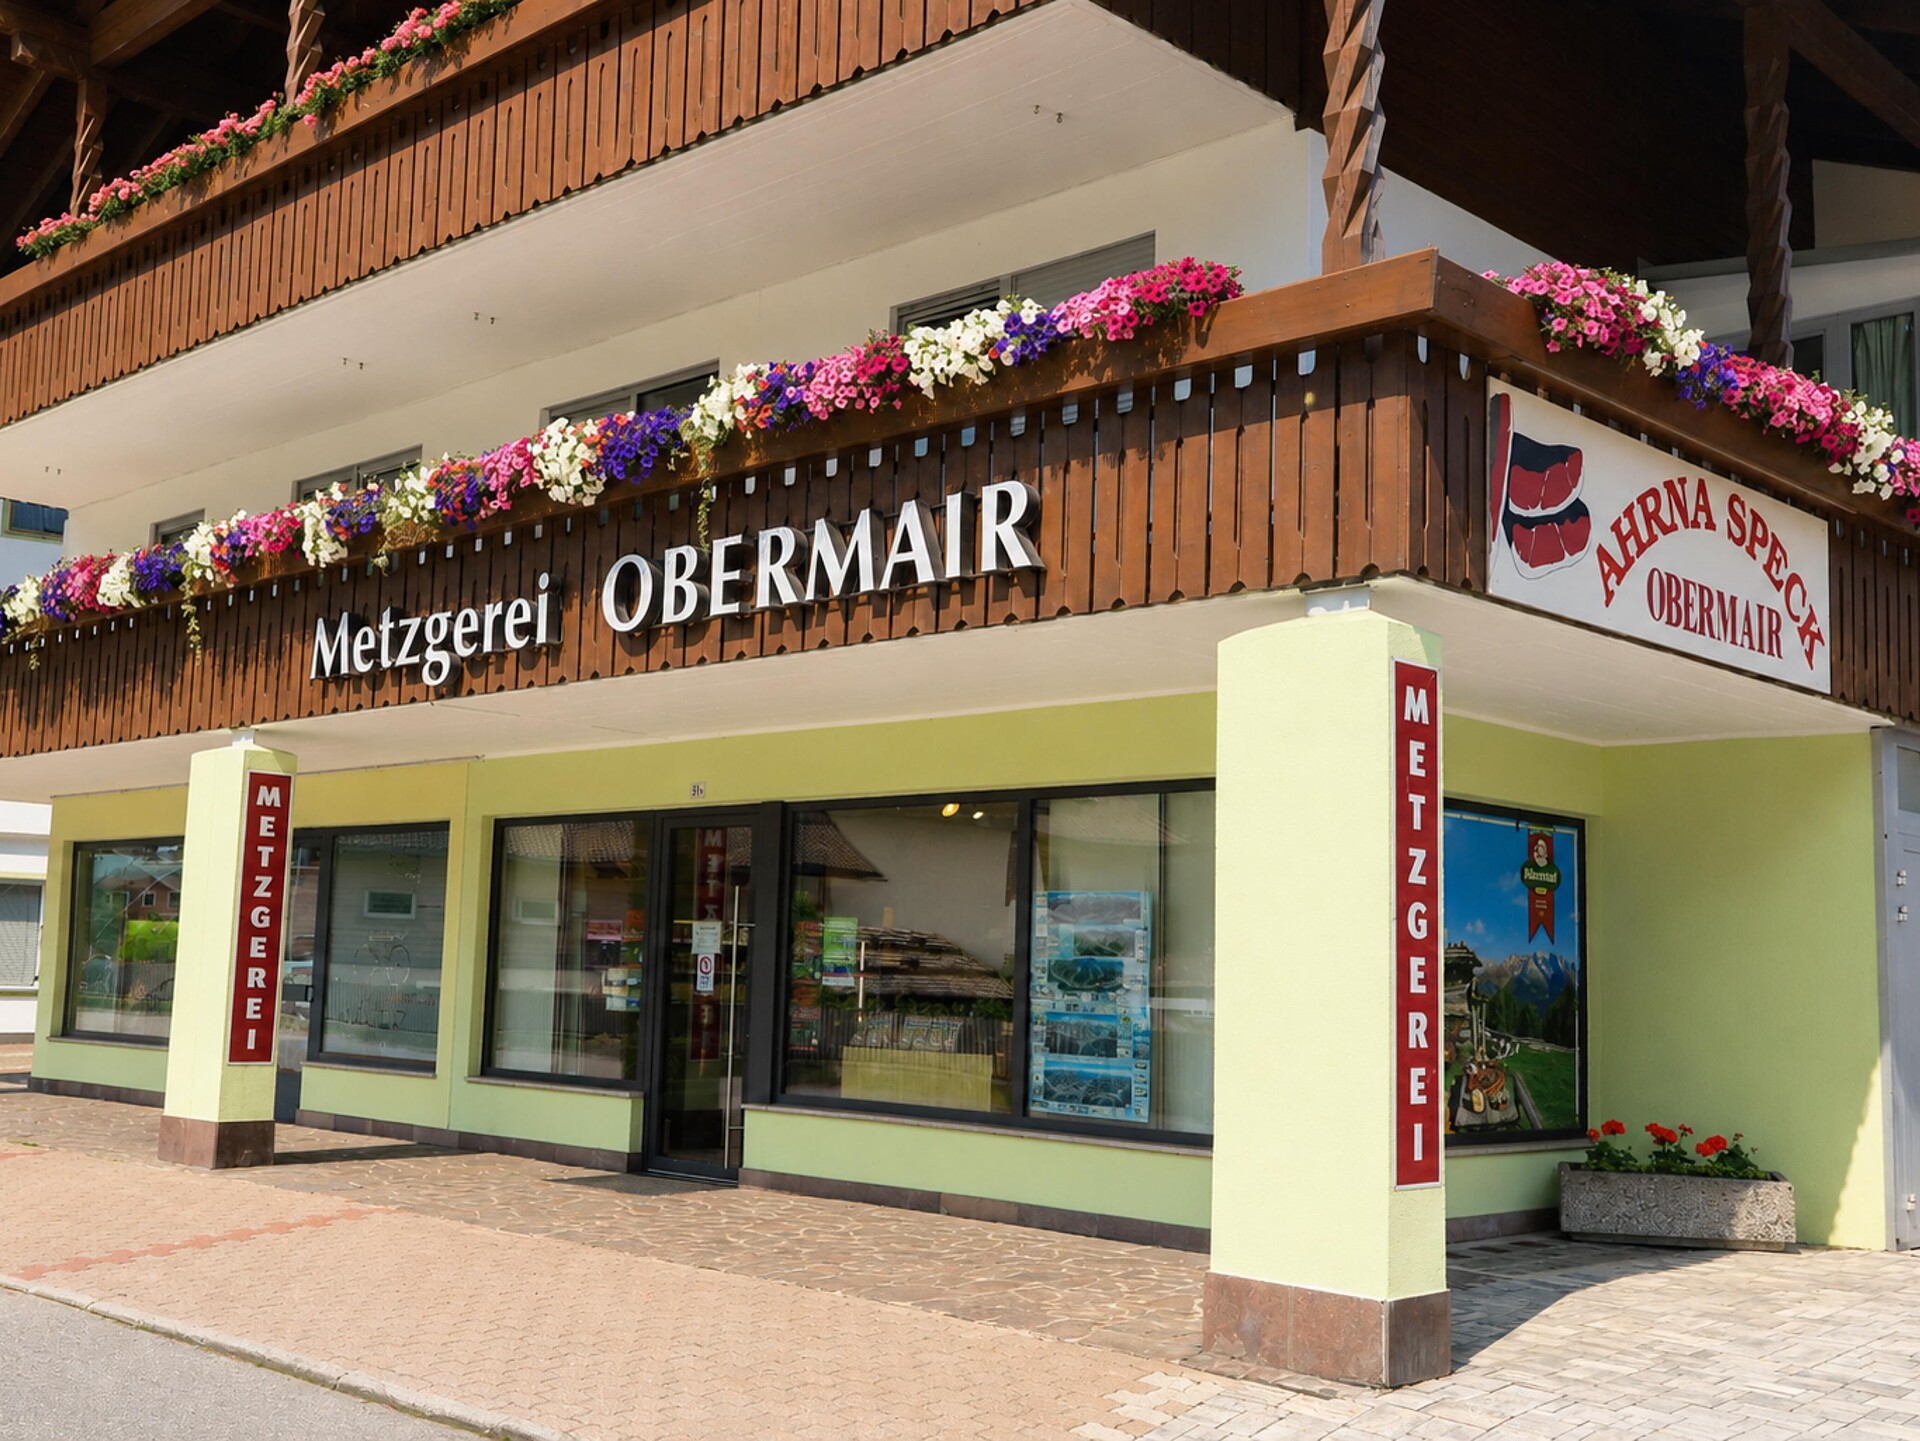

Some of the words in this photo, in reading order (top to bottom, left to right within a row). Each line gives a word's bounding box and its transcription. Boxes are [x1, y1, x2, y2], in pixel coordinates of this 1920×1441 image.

[310, 572, 549, 686] Metzgerei
[602, 480, 1038, 632] OBERMAIR
[1595, 476, 1717, 608] AHRNA
[1726, 493, 1825, 671] SPECK
[1646, 567, 1783, 660] OBERMAIR
[245, 785, 281, 1050] METZGEREI
[1403, 685, 1430, 1161] METZGEREI
